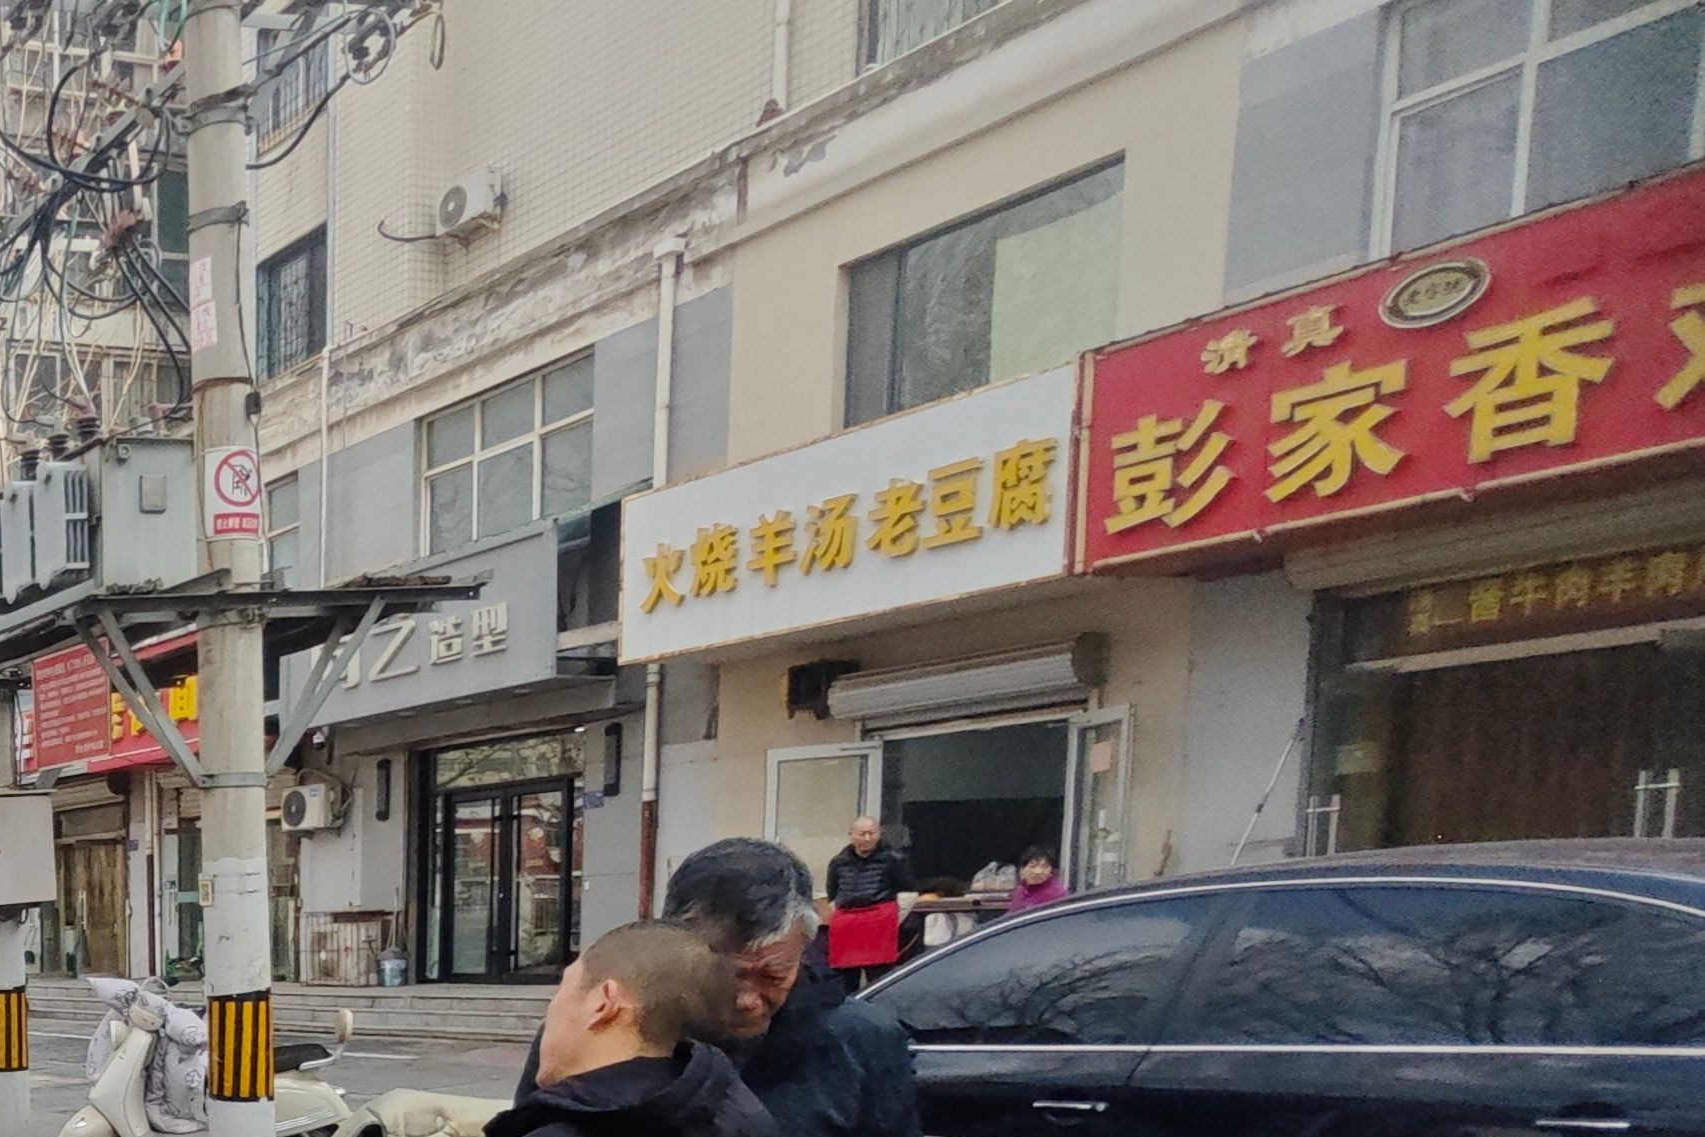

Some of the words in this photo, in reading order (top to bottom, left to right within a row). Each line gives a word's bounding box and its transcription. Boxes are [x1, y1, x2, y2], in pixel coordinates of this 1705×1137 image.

[1200, 304, 1346, 375] 清真
[640, 437, 1059, 614] 火烧羊汤老豆腐
